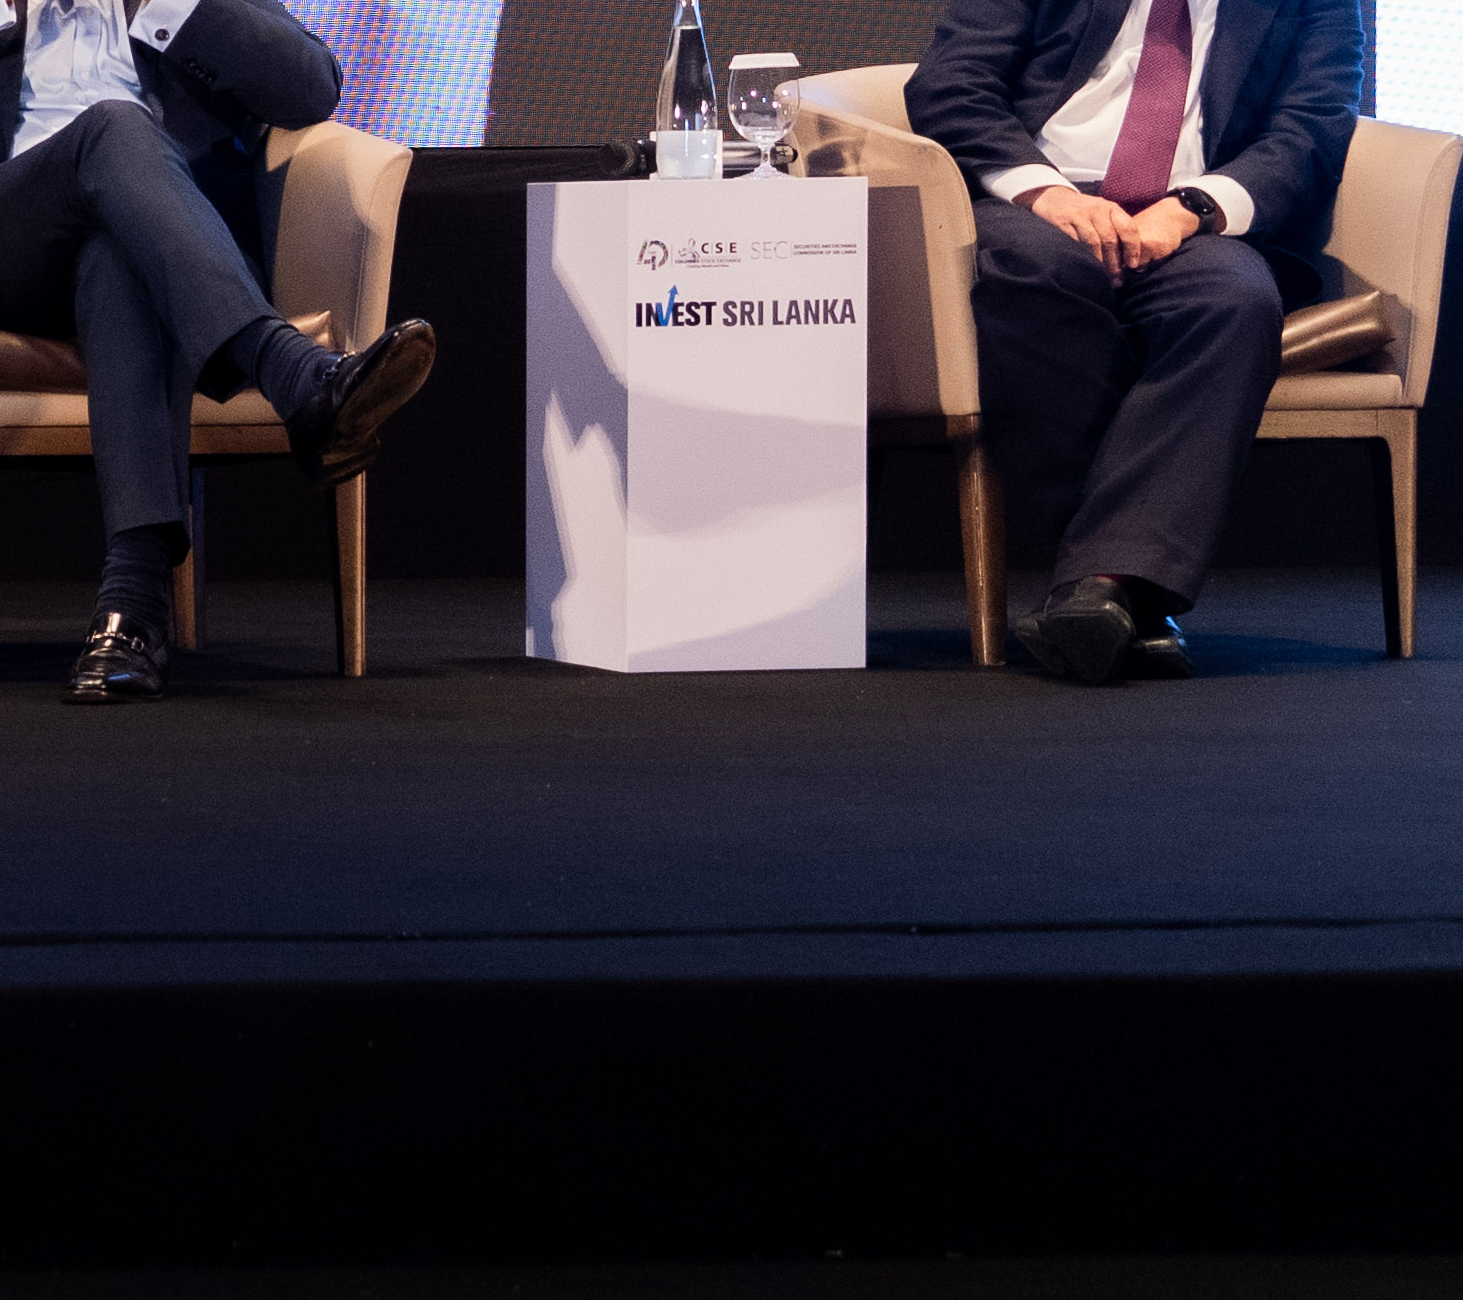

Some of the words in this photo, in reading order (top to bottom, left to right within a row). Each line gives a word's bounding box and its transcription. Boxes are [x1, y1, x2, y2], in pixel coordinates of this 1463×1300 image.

[750, 241, 788, 260] SEC
[636, 285, 717, 327] INVEST
[722, 300, 764, 327] SRI
[772, 298, 856, 325] LANKA
